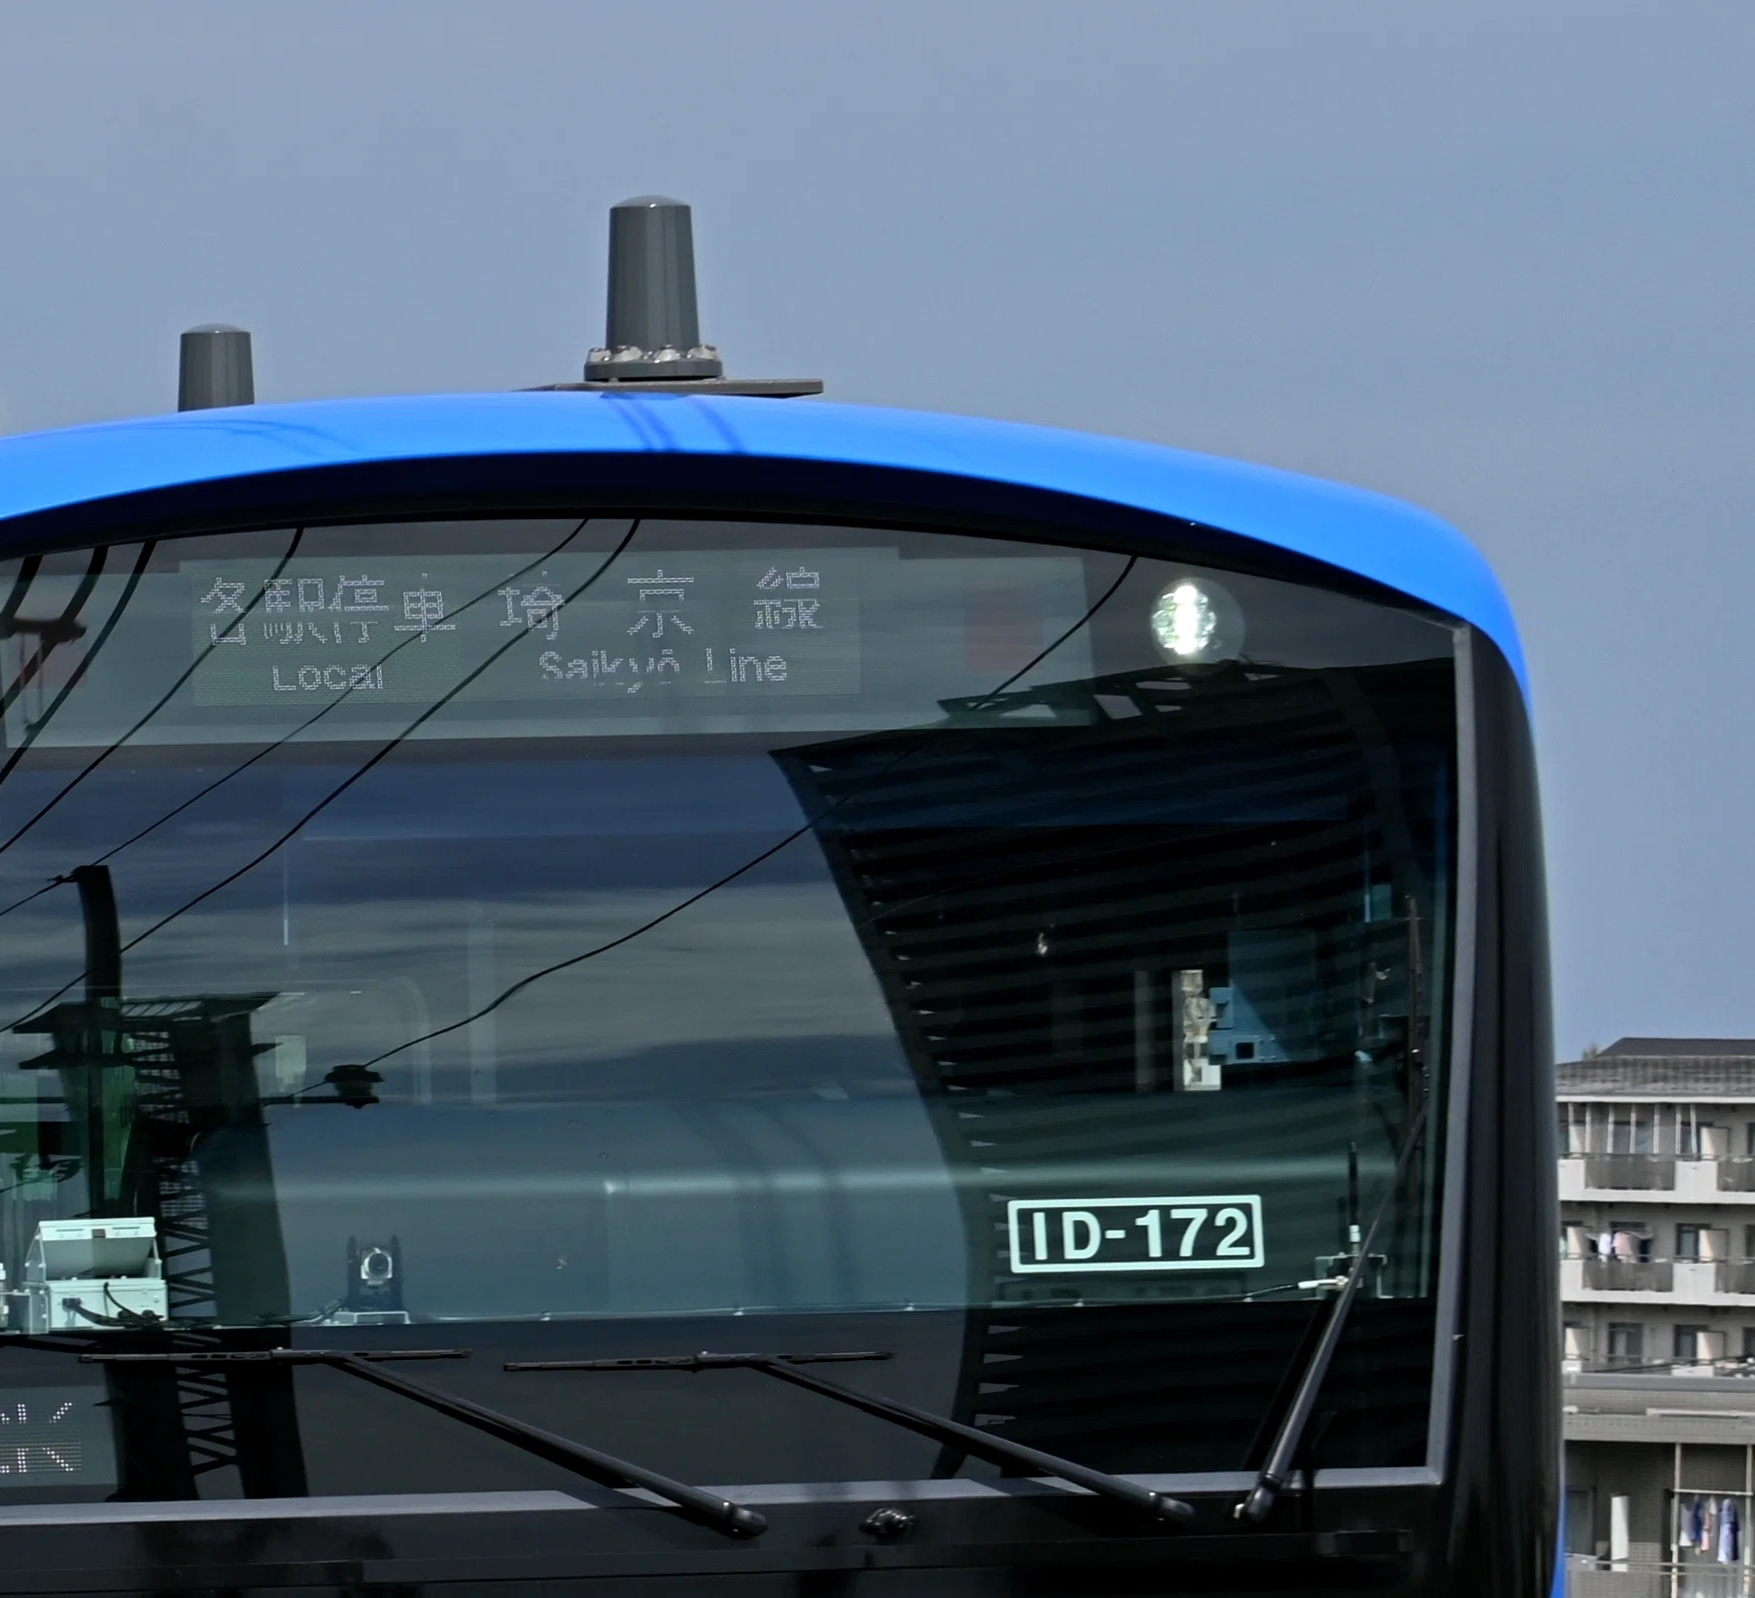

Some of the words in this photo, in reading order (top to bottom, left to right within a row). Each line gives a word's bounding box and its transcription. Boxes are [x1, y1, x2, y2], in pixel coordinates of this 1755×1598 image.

[272, 664, 384, 692] Local
[704, 648, 788, 685] Line
[1032, 1207, 1251, 1261] ID-172
